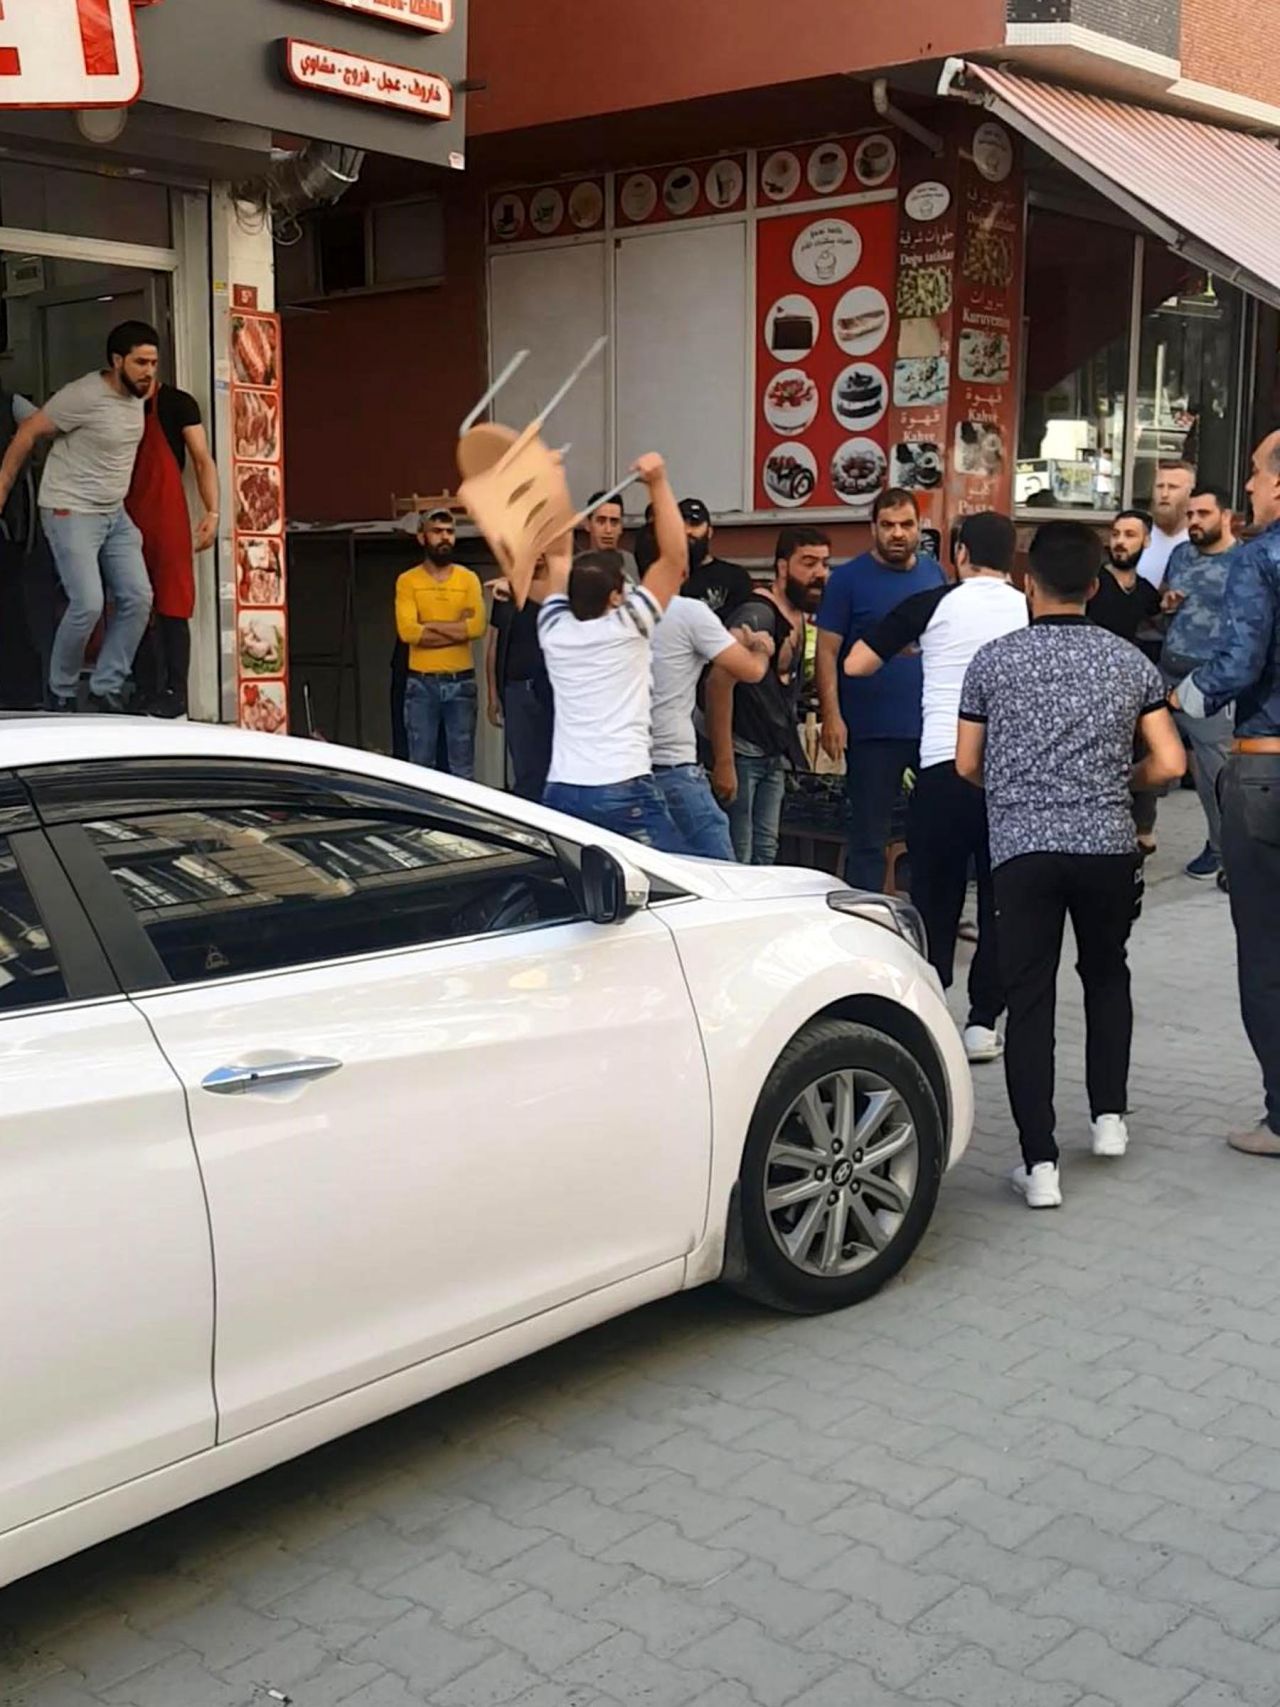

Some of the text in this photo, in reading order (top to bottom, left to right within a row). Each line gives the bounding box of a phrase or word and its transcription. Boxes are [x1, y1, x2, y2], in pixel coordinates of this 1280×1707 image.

[300, 54, 336, 77] مشاوي
[343, 65, 370, 86] فروج
[377, 71, 401, 94] عجل
[408, 78, 442, 103] خاروف
[900, 409, 941, 430] قهوة
[903, 430, 936, 442] Kahve
